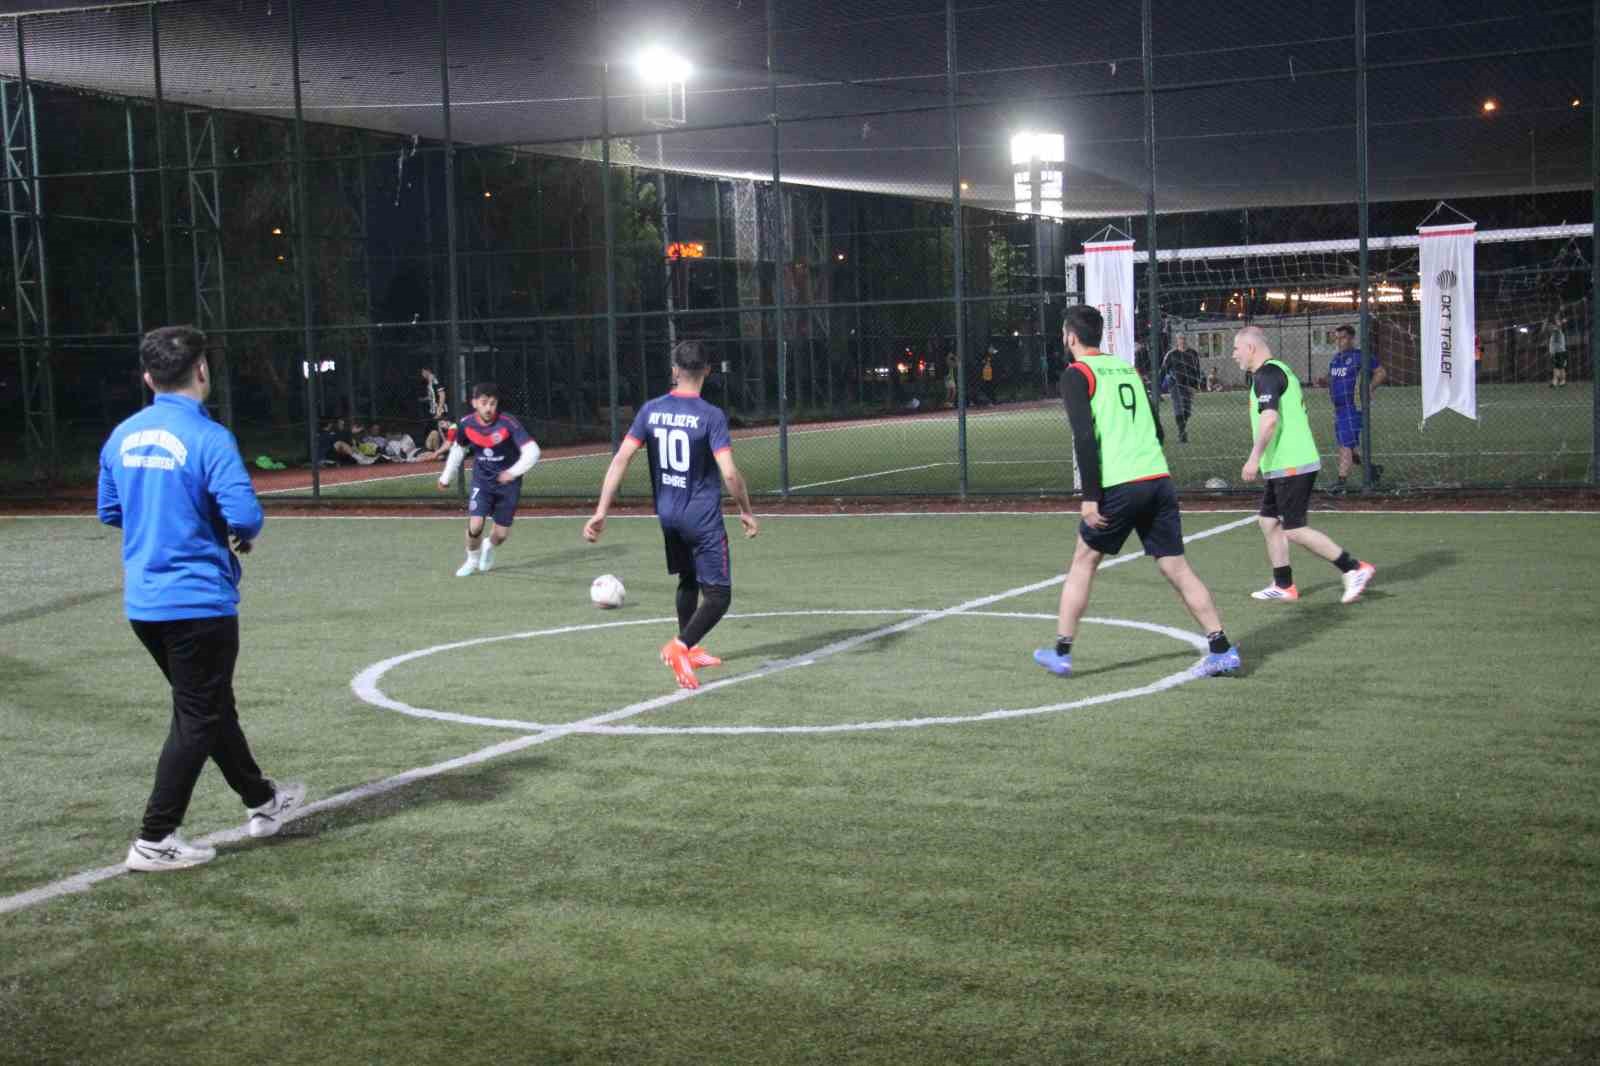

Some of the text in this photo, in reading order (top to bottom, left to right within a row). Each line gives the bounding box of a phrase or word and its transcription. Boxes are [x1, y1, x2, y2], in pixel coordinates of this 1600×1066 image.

[1441, 295, 1452, 321] OKT
[1118, 383, 1136, 423] 9
[654, 428, 690, 472] 10
[472, 487, 480, 500] 7
